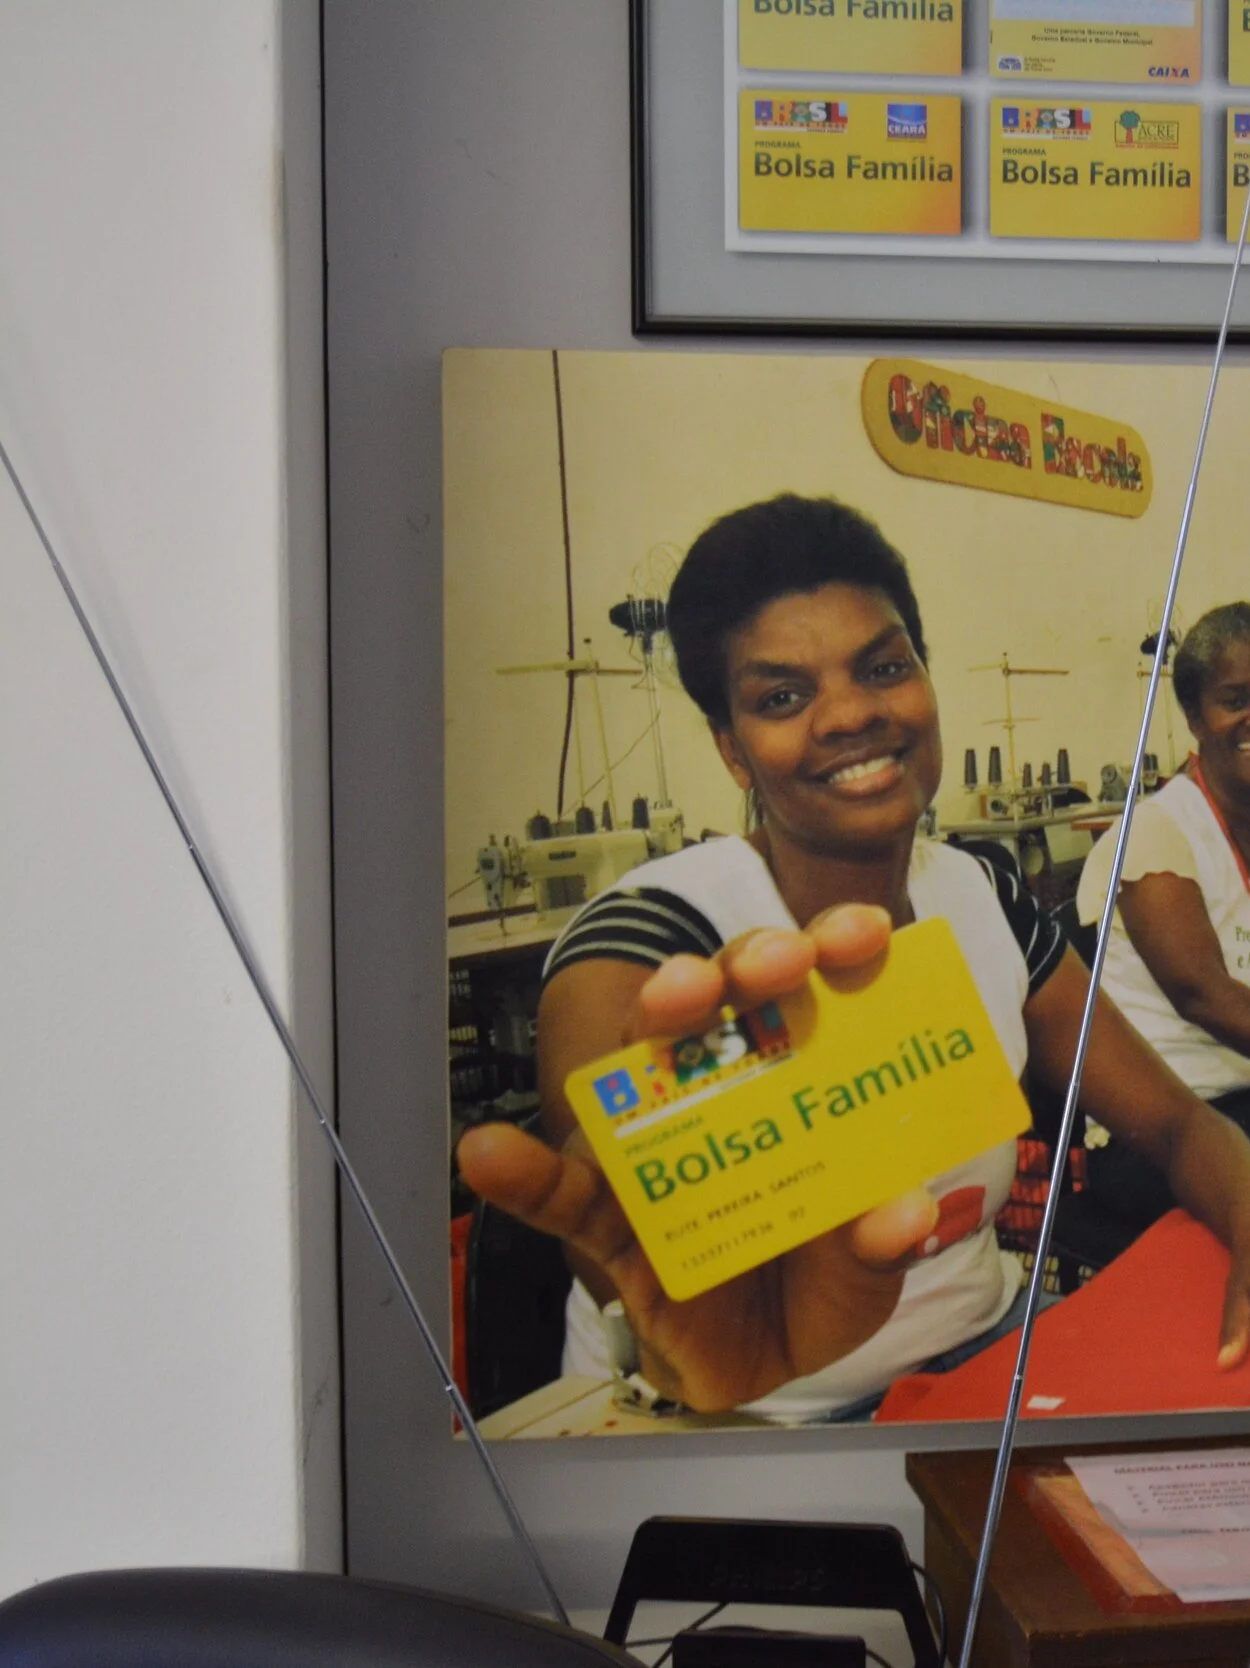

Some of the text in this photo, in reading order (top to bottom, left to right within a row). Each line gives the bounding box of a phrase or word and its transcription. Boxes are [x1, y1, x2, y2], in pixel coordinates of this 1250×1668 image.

[1148, 67, 1190, 78] CAIXA
[754, 152, 954, 182] Bolsa Família
[1002, 148, 1047, 156] PROGRAMA
[1002, 159, 1191, 188] Bolsa Família
[634, 1116, 784, 1205] Bolsa
[792, 1025, 976, 1132] Família
[623, 1115, 705, 1160] PROGRAMA
[706, 1190, 763, 1222] PEREIRA
[769, 1161, 827, 1193] SANTOS
